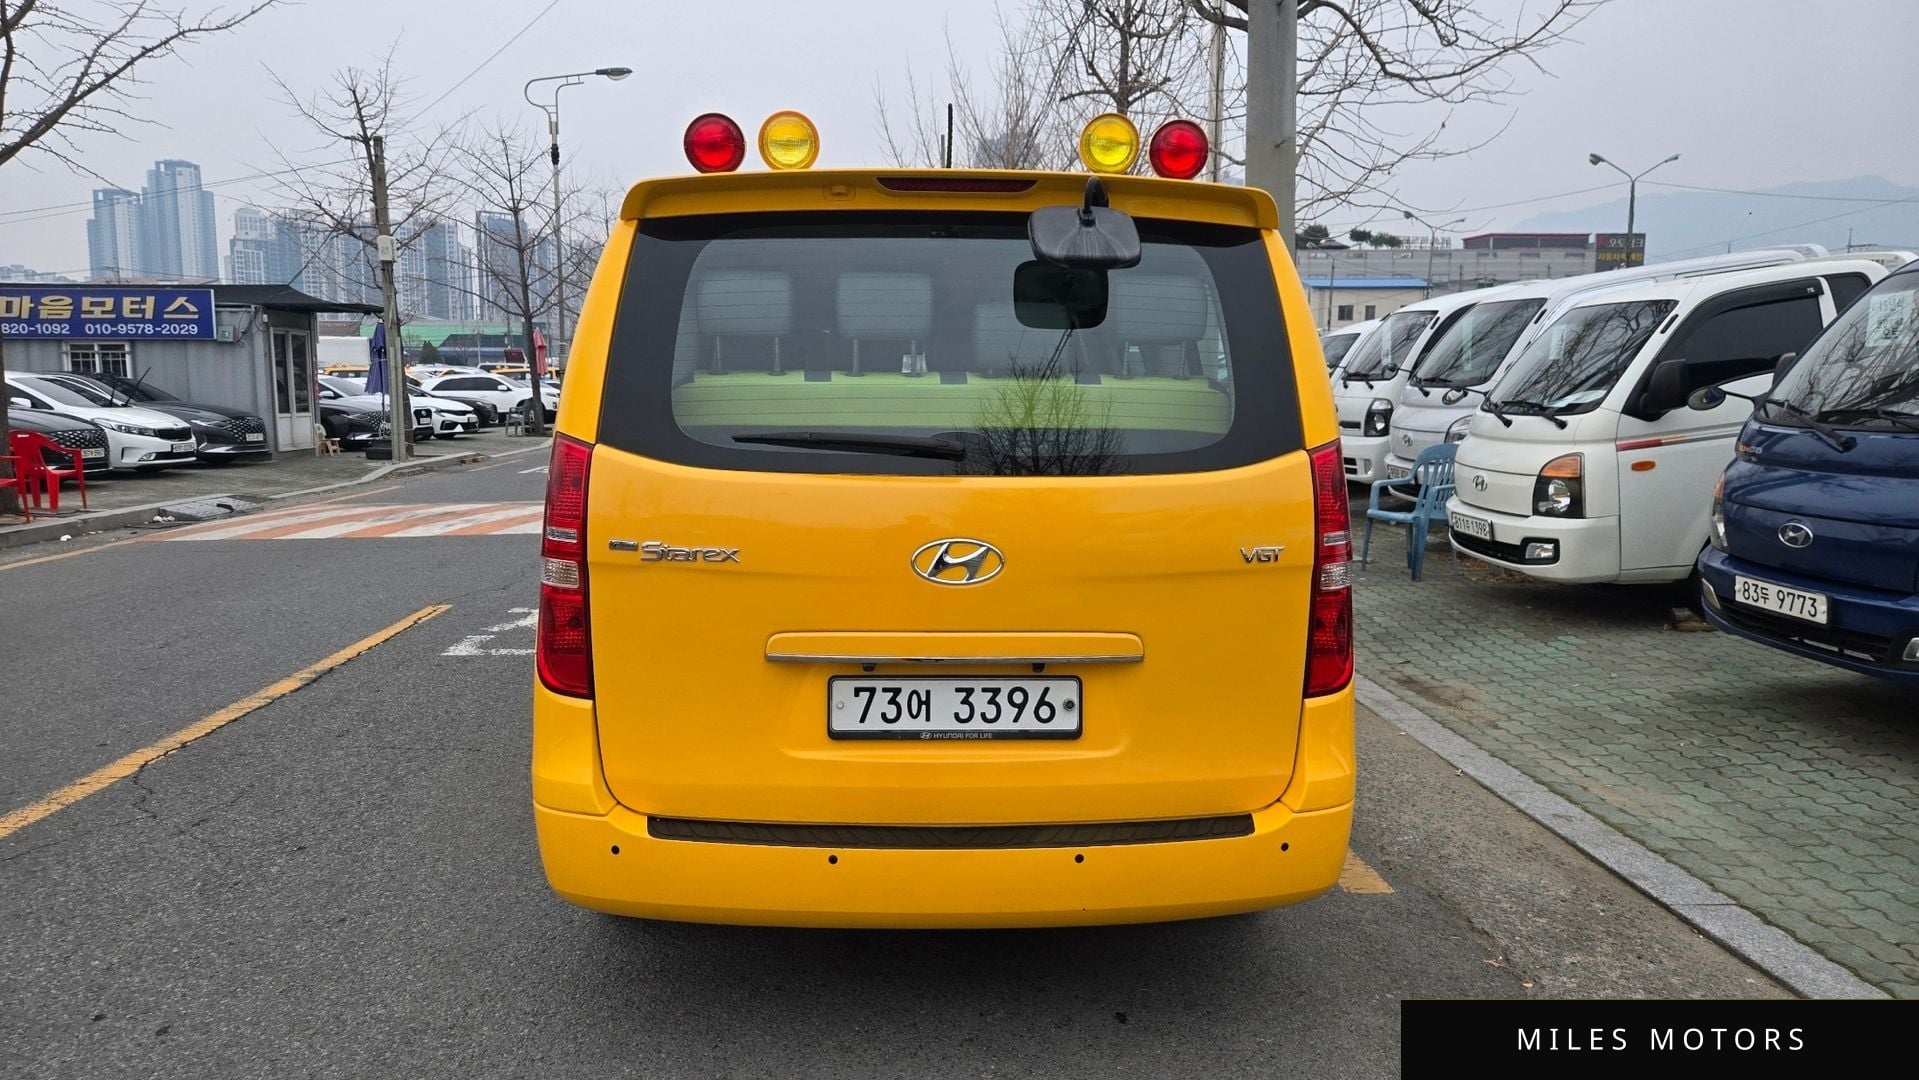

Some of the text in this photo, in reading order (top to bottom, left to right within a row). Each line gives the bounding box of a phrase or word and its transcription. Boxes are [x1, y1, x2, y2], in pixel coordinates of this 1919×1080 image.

[1, 323, 199, 336] 820-1092 010-9578-2029
[641, 541, 741, 563] Starex
[1240, 546, 1285, 563] VGT
[1742, 581, 1817, 618] 83두 9773
[853, 686, 1057, 724] 73어 3396
